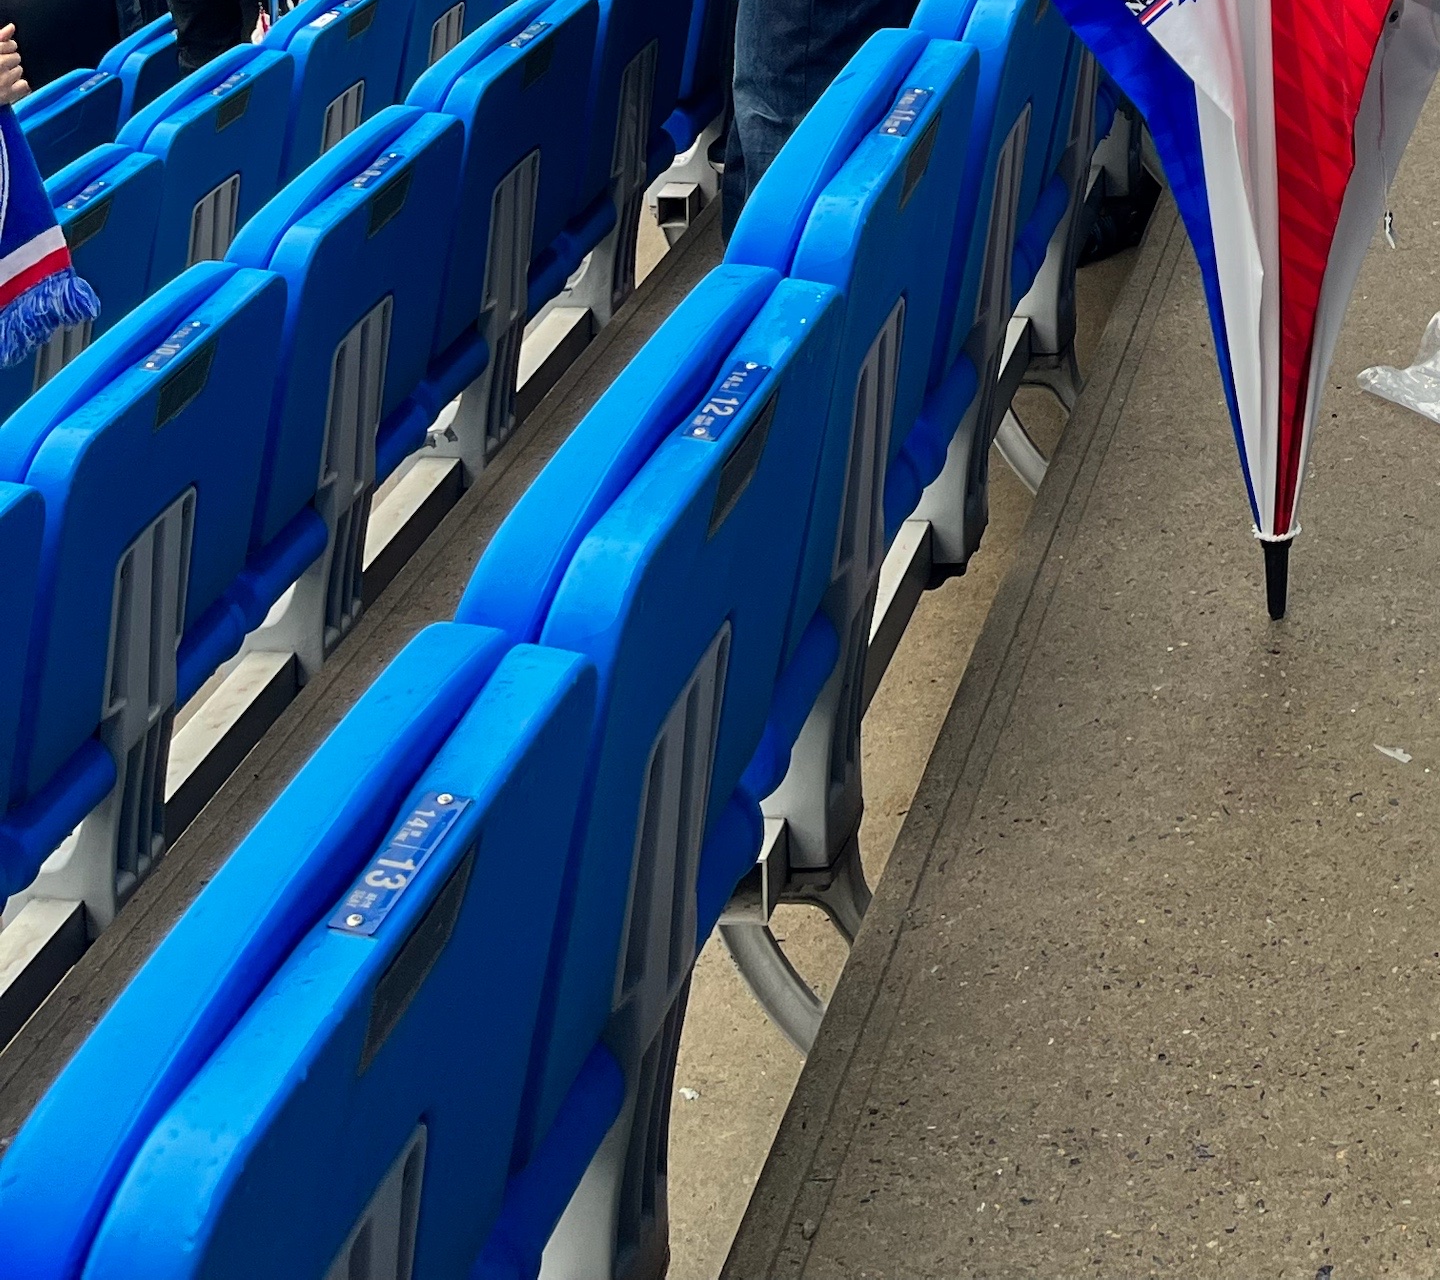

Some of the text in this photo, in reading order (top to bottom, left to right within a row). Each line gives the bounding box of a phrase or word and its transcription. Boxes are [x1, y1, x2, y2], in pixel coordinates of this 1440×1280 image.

[156, 343, 180, 355] 10
[702, 397, 739, 416] 12
[406, 810, 436, 828] 14
[365, 858, 416, 890] 13
